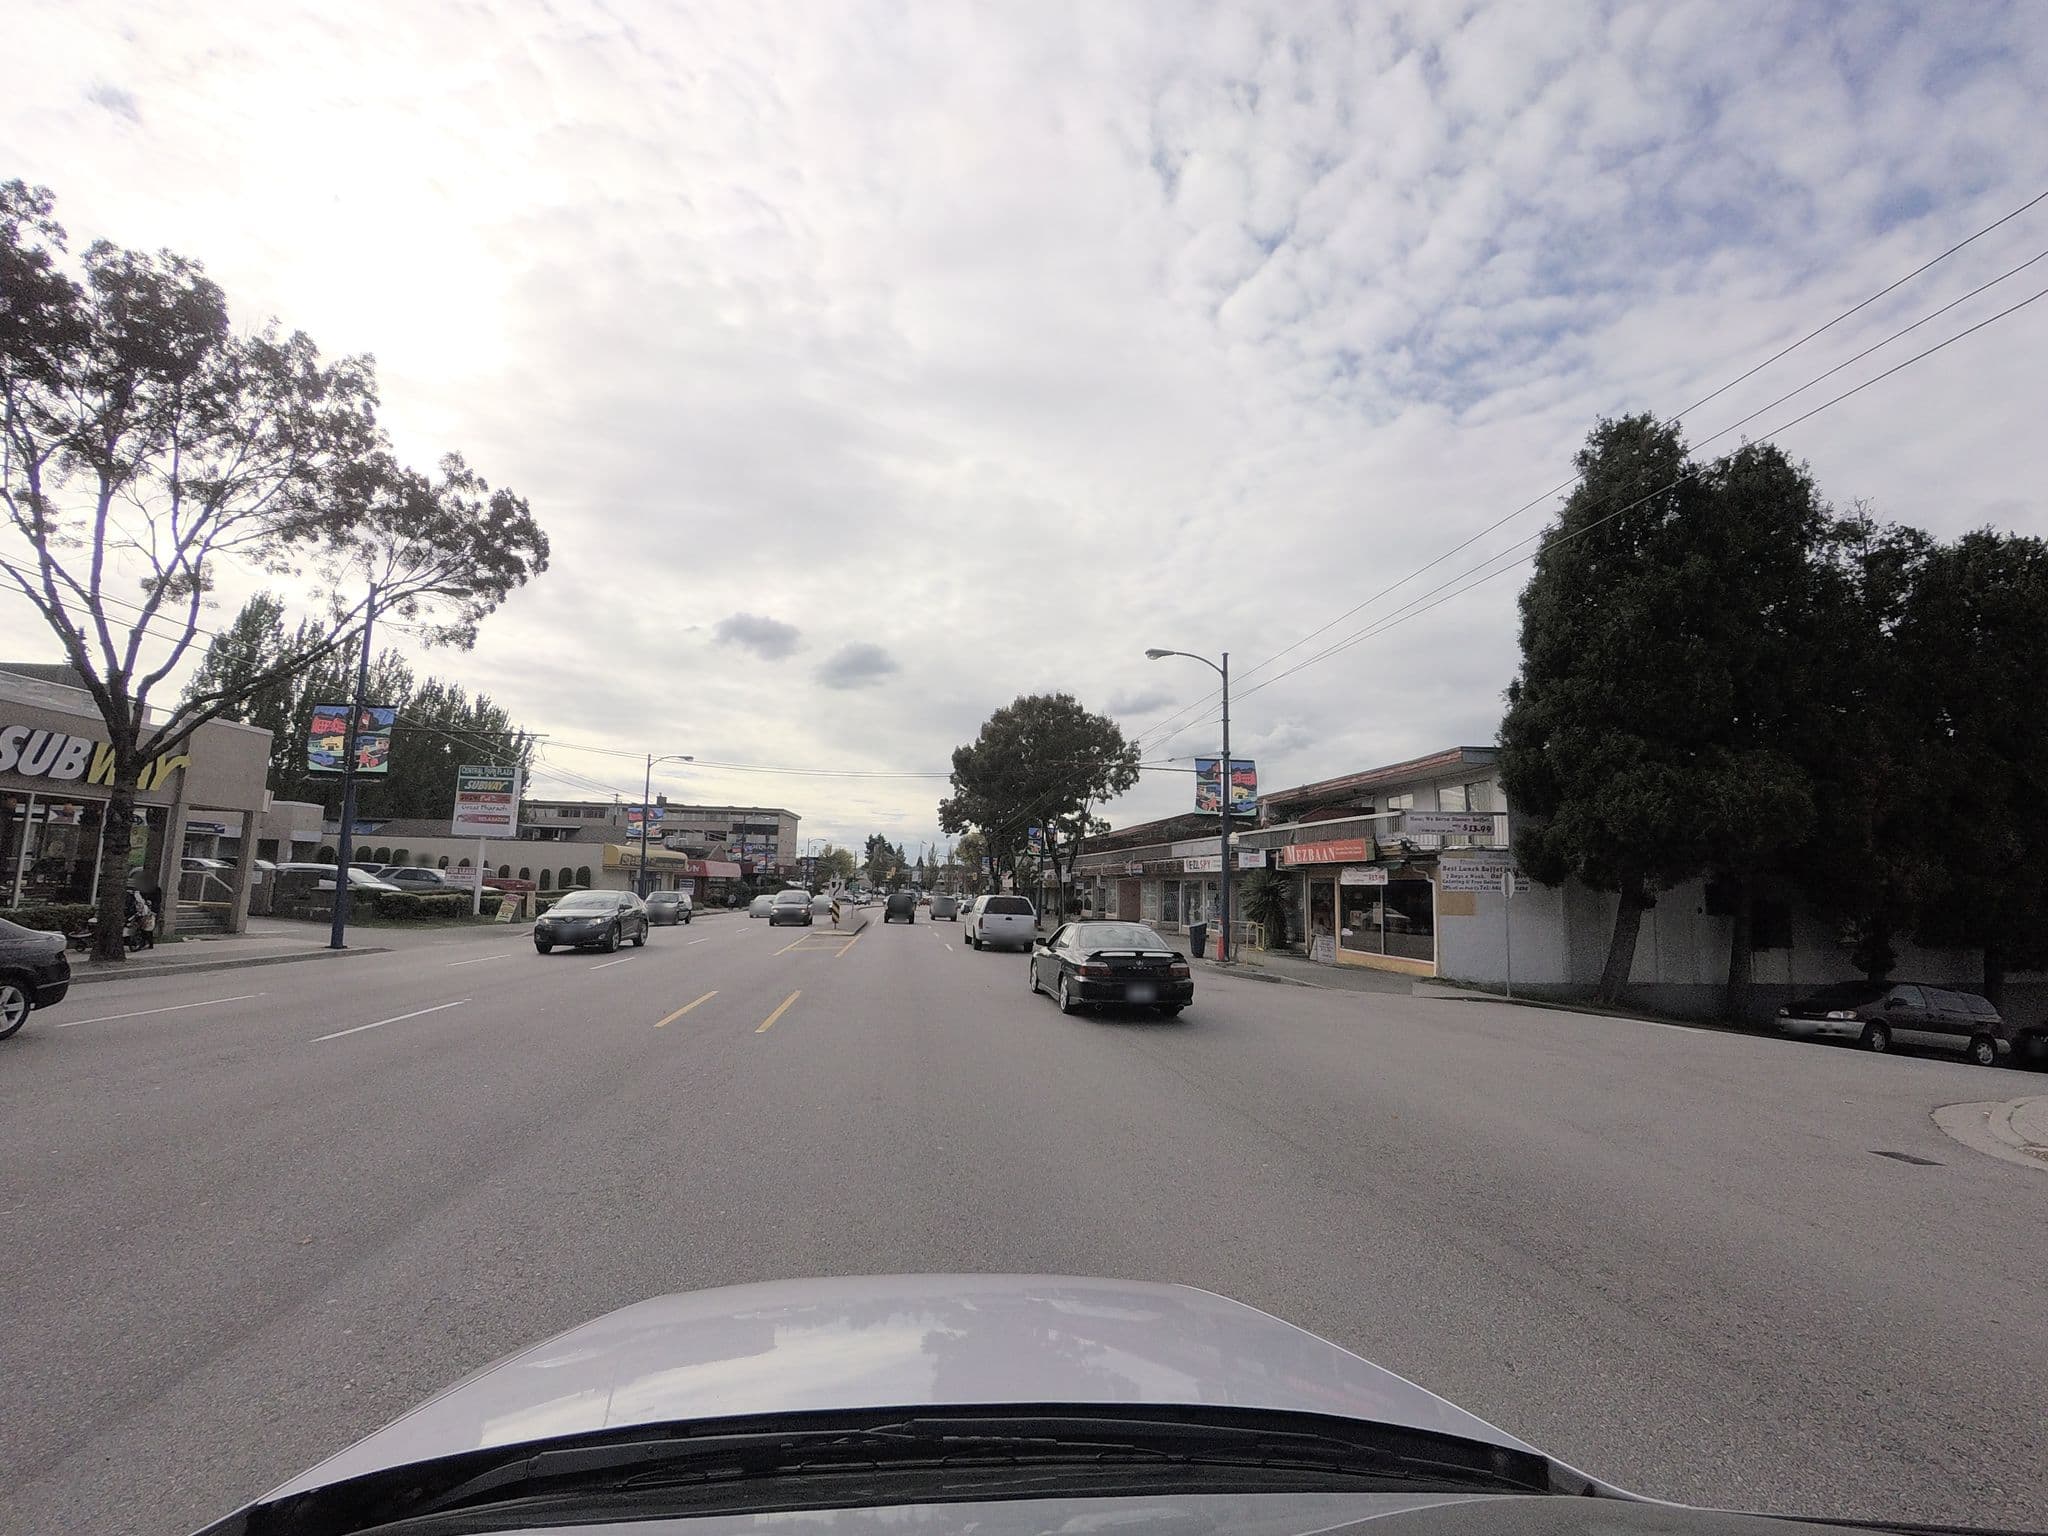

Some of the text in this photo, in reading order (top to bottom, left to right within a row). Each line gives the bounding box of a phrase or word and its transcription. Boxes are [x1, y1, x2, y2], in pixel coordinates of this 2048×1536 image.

[0, 724, 191, 791] SUBWY
[464, 780, 509, 791] SUBWAY
[1285, 845, 1335, 863] MEZBAAN
